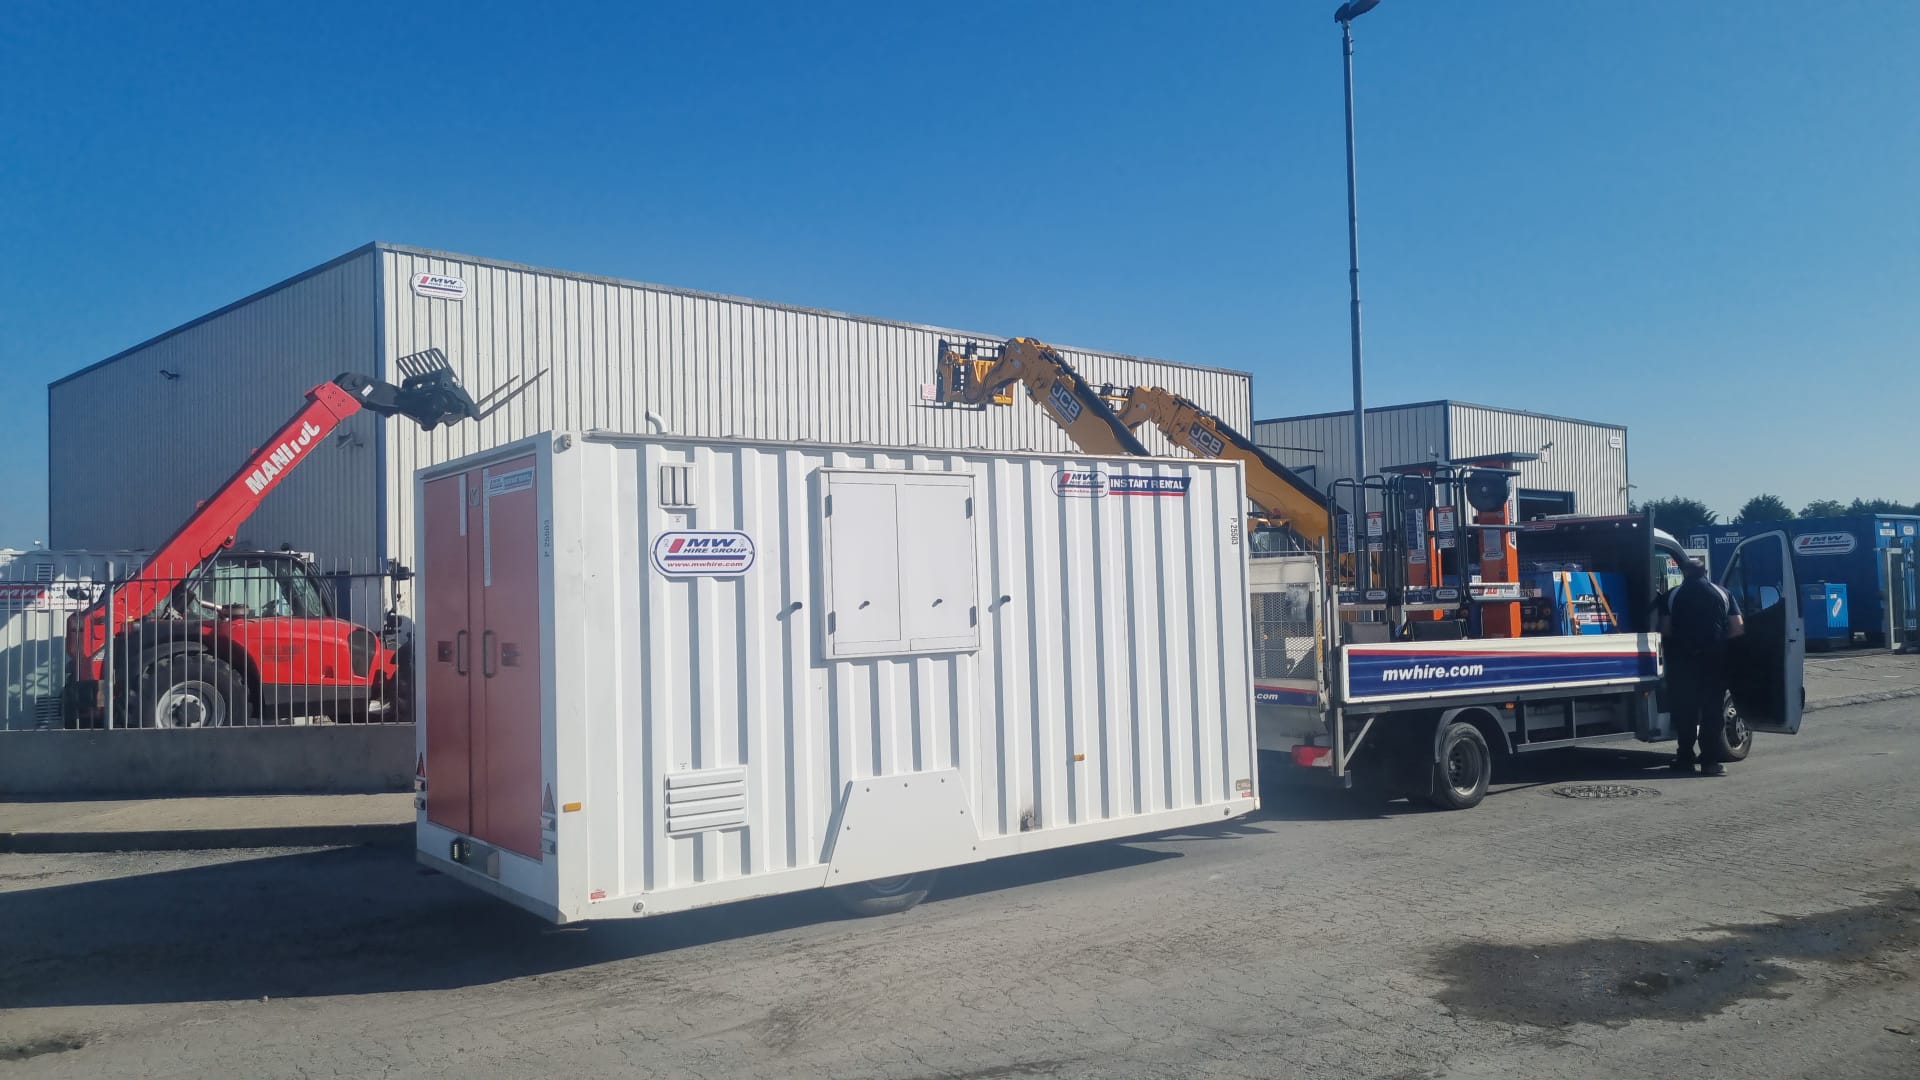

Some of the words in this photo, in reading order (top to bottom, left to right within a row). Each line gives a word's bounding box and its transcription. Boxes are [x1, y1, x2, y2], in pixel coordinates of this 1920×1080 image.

[1052, 386, 1080, 418] JCB
[1190, 427, 1223, 454] JCB
[1071, 473, 1099, 481] MW
[686, 538, 737, 548] MW
[1382, 663, 1484, 682] mwhire.com
